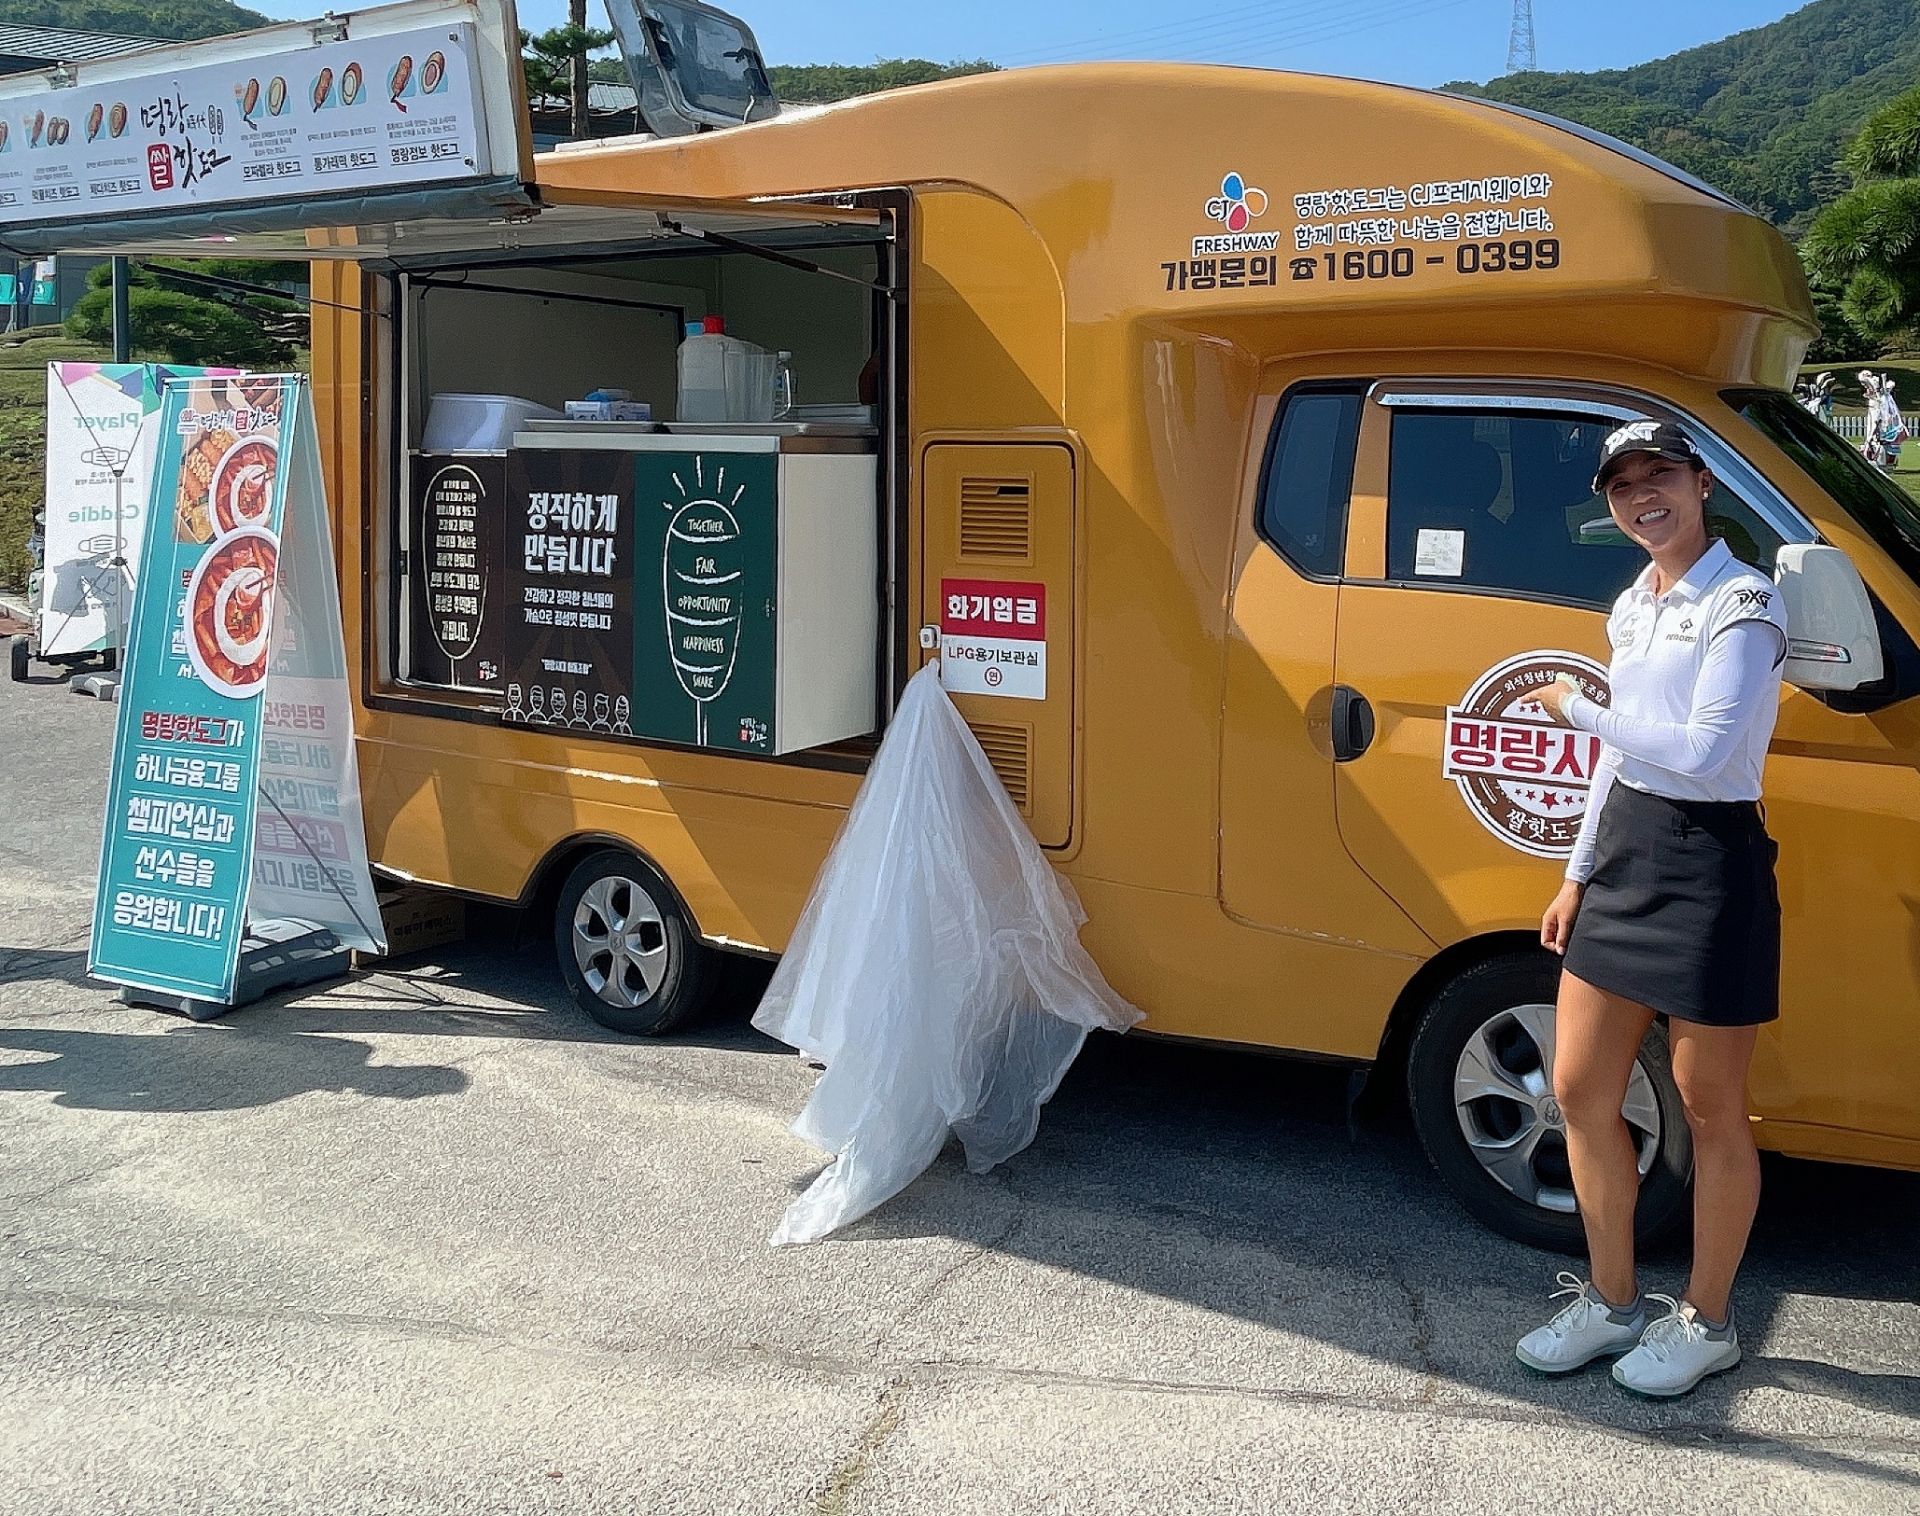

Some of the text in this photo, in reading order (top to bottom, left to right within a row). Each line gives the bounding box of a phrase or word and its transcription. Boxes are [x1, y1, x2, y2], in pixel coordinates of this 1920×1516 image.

[350, 153, 377, 167] 핫도그
[391, 143, 460, 163] 명랑점보 핫도그
[277, 161, 301, 175] 핫도그
[1294, 174, 1551, 218] 명랑핫도그는 CJ프레시웨이와
[1206, 199, 1231, 221] CJ
[1294, 207, 1553, 250] 함께 따뜻한 나눔을 전합니다.
[1193, 234, 1279, 257] FRESHWAY
[1160, 255, 1277, 290] 가맹문의
[1323, 246, 1415, 281] 1600
[1455, 238, 1560, 274] 0399
[526, 492, 619, 533] 정직하게
[688, 518, 725, 534] TOGETHER
[524, 534, 617, 576] 만듭니다
[695, 557, 717, 574] FAIR
[524, 587, 555, 604] 건강하고
[678, 595, 731, 613] OPPORTUNITY
[524, 608, 611, 630] 가슴으로 정성껏 만듭니다
[947, 594, 1037, 624] 화기엄금
[683, 636, 724, 653] HAPPINESS
[948, 646, 1039, 666] LPG용기보관실
[692, 674, 714, 688] SHARE
[142, 711, 245, 747] 명랑핫도그가
[1450, 721, 1600, 782] 명랑시
[134, 753, 241, 793] 하나금융그룹
[127, 797, 235, 843] 챔피언십과
[134, 846, 216, 889] 선수들을
[112, 891, 225, 941] 응원합니다!
